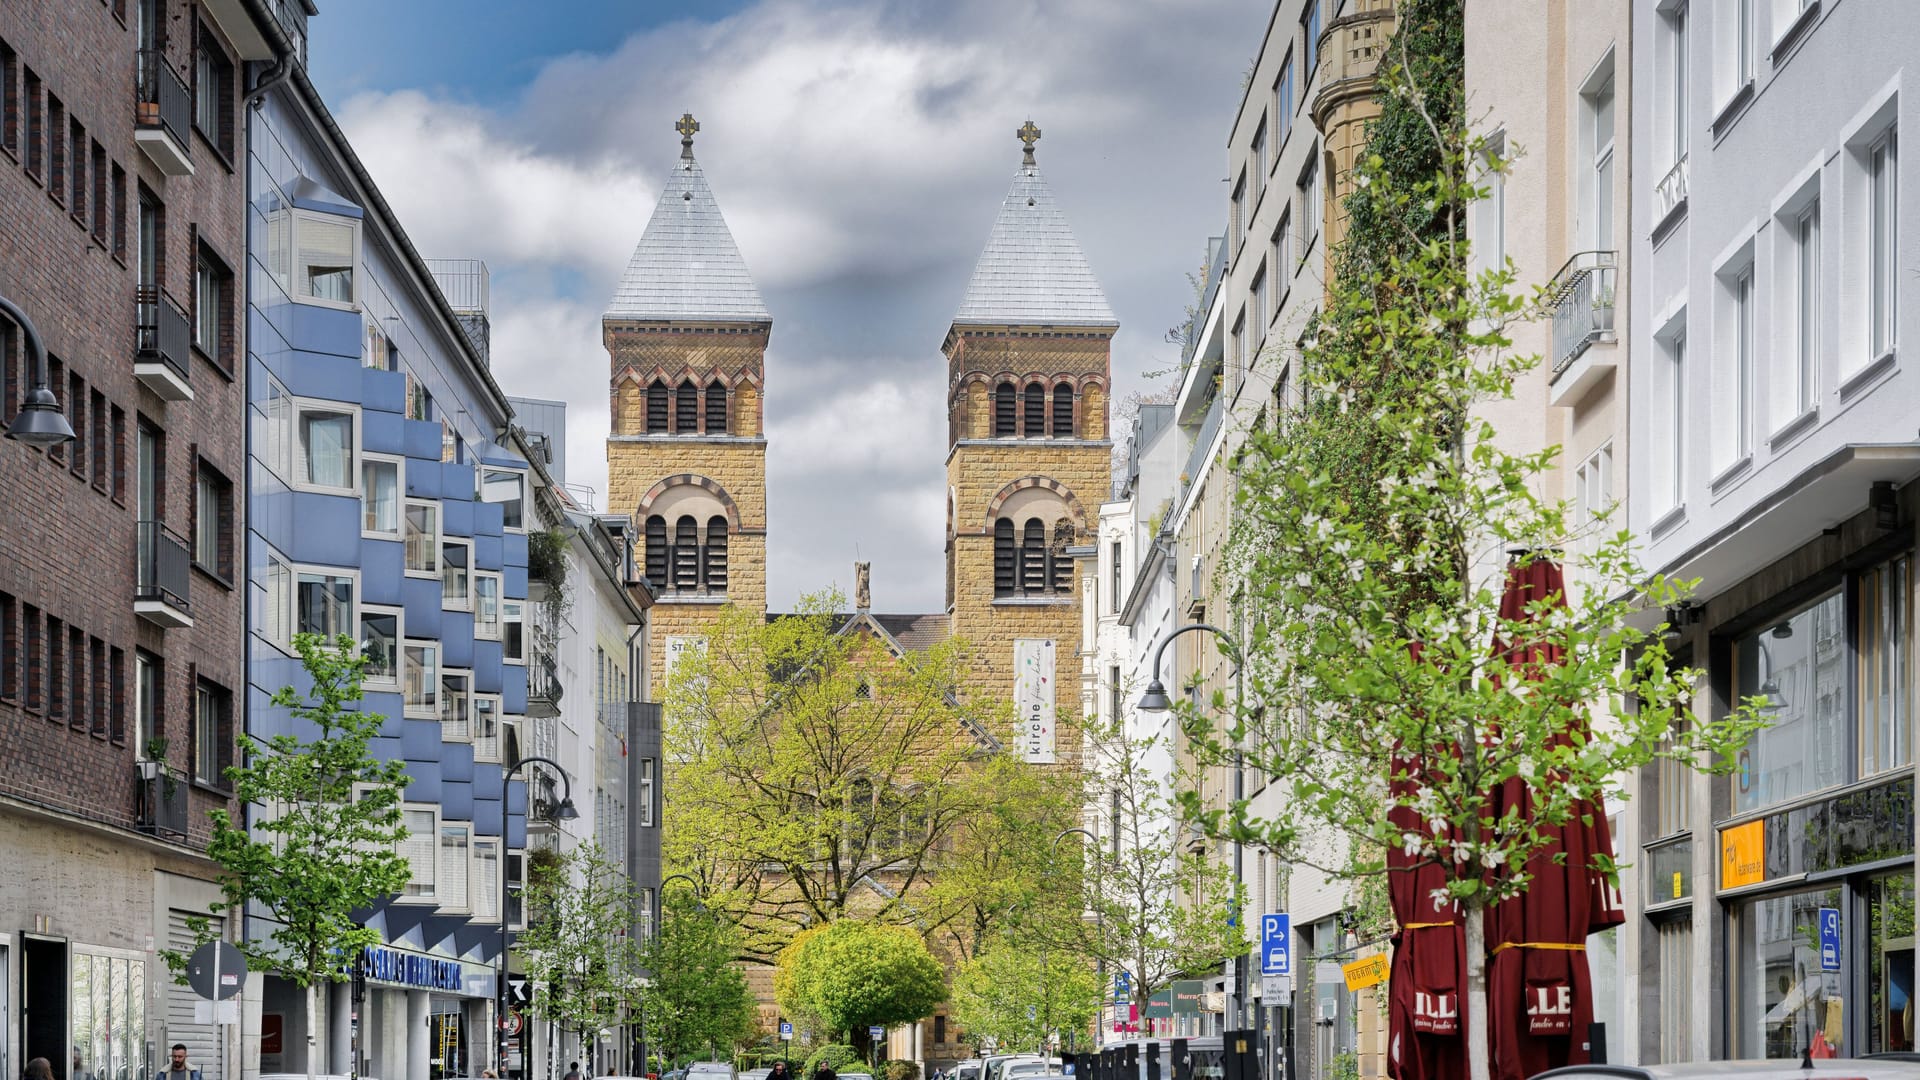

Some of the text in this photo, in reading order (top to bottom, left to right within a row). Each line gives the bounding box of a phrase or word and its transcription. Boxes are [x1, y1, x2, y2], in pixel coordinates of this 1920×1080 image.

[1029, 703, 1041, 755] kirche
[1265, 918, 1278, 942] P
[1415, 992, 1457, 1018] ILL
